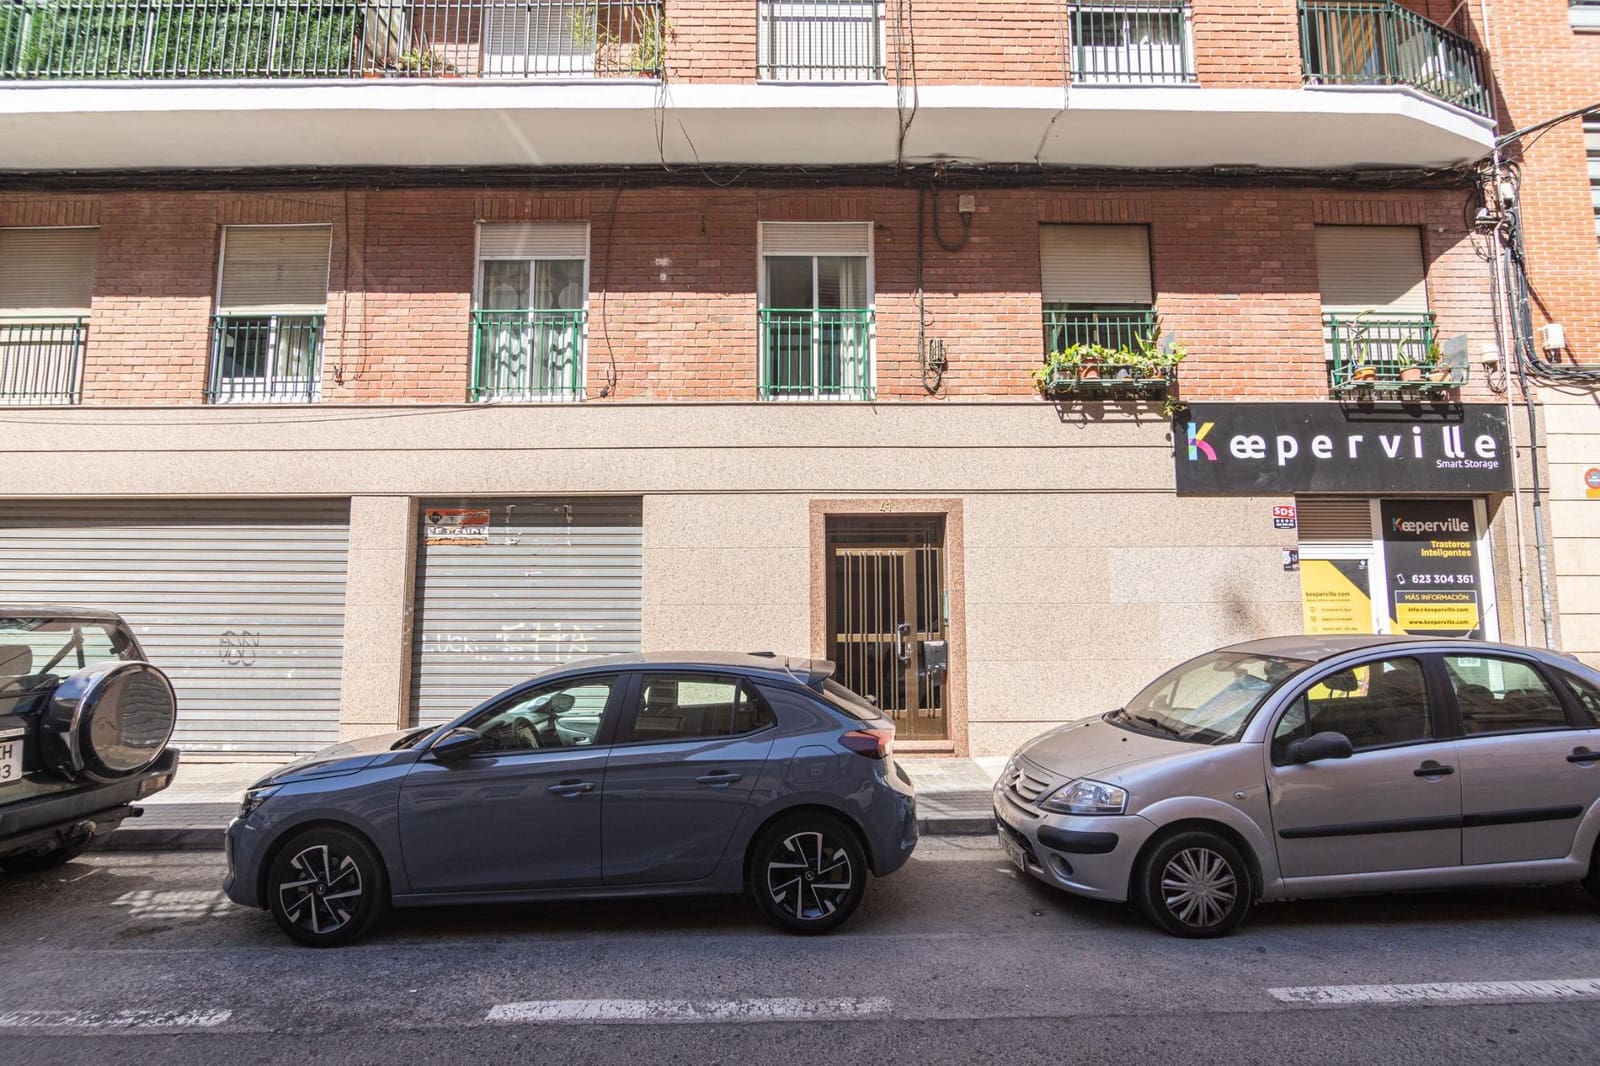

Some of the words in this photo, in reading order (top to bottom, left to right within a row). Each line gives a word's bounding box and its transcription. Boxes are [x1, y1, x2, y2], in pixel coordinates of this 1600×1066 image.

[1186, 421, 1497, 466] Keeperville
[1436, 458, 1463, 469] Smart
[1464, 459, 1499, 470] Storage
[1273, 506, 1296, 518] SDS
[1392, 518, 1469, 535] Keeperville
[1430, 540, 1471, 549] Trasteros
[1421, 548, 1472, 558] Inteligentes
[1411, 574, 1431, 584] 623
[1433, 574, 1454, 584] 304
[1456, 574, 1474, 584] 361
[1404, 593, 1419, 601] MÁS
[0, 764, 12, 780] 3
